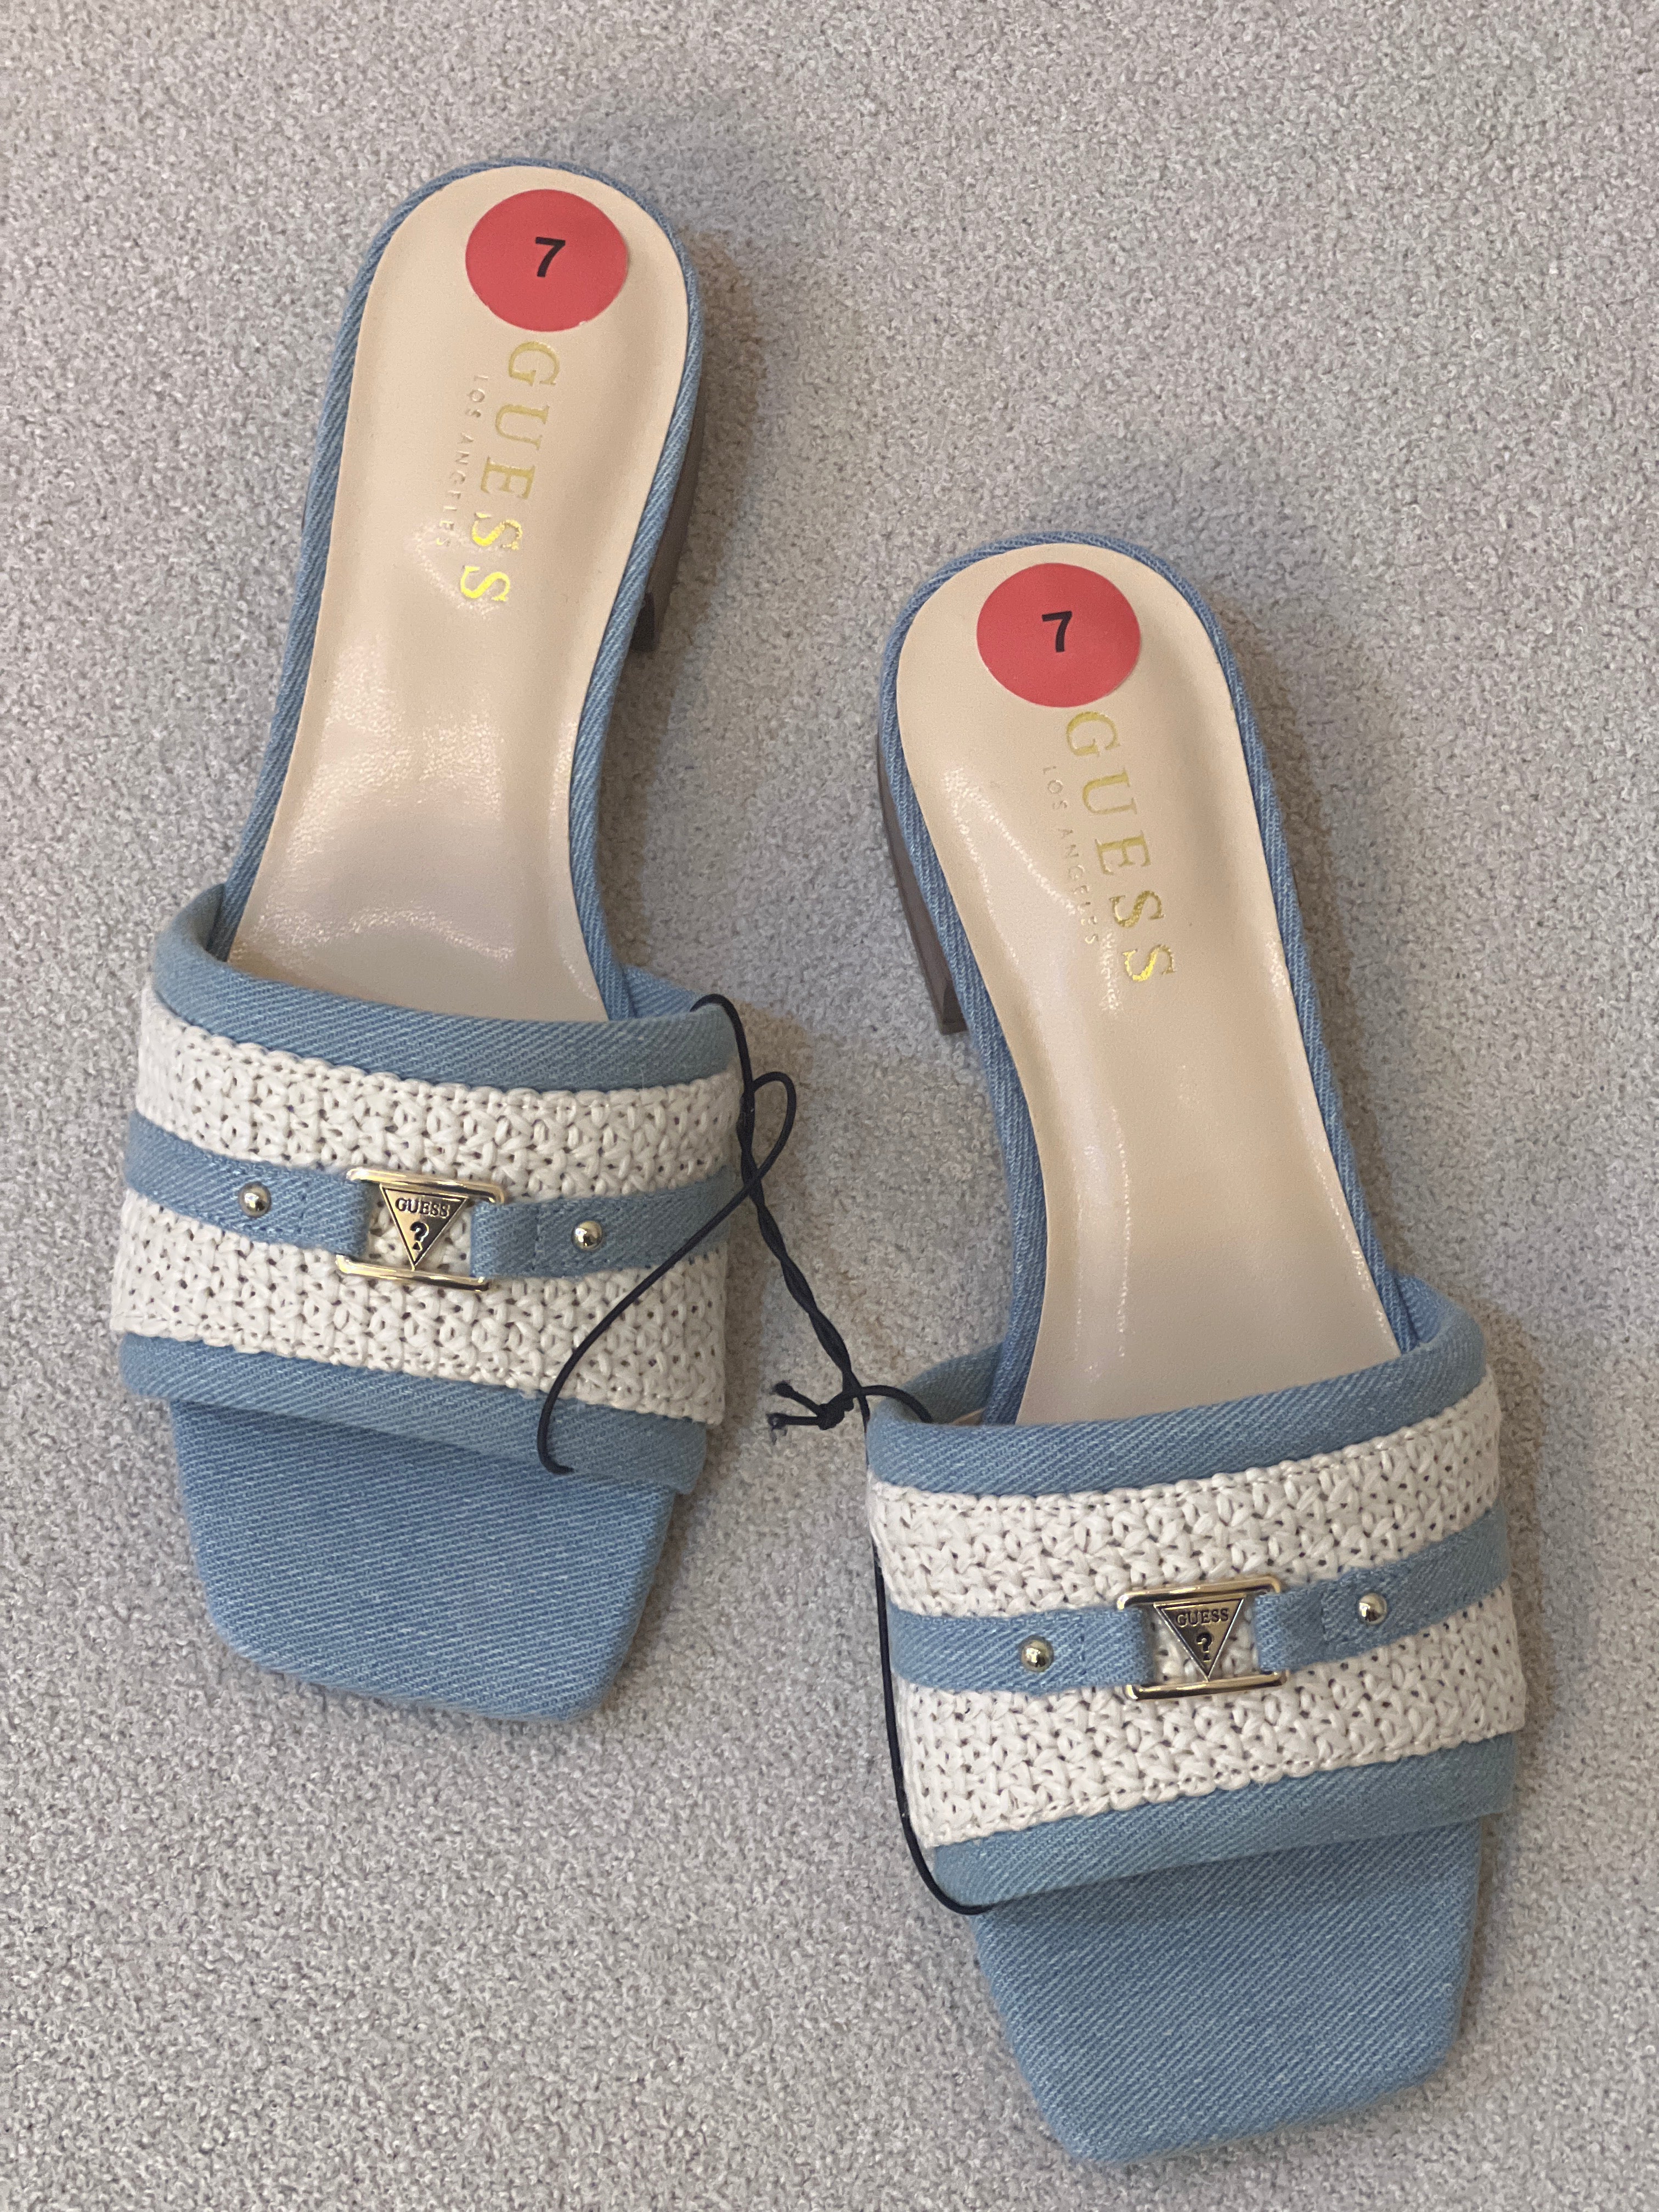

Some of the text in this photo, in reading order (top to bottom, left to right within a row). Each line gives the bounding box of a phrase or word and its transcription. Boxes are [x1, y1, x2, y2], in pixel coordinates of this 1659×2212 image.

[534, 236, 566, 278] 7
[464, 374, 489, 419] LOS
[460, 341, 561, 602] GUESS
[1041, 611, 1074, 653] 7
[1042, 765, 1068, 811] LOS
[1065, 711, 1176, 983] GUESS
[394, 1197, 451, 1219] GUESS
[1177, 1607, 1230, 1628] GUESS
